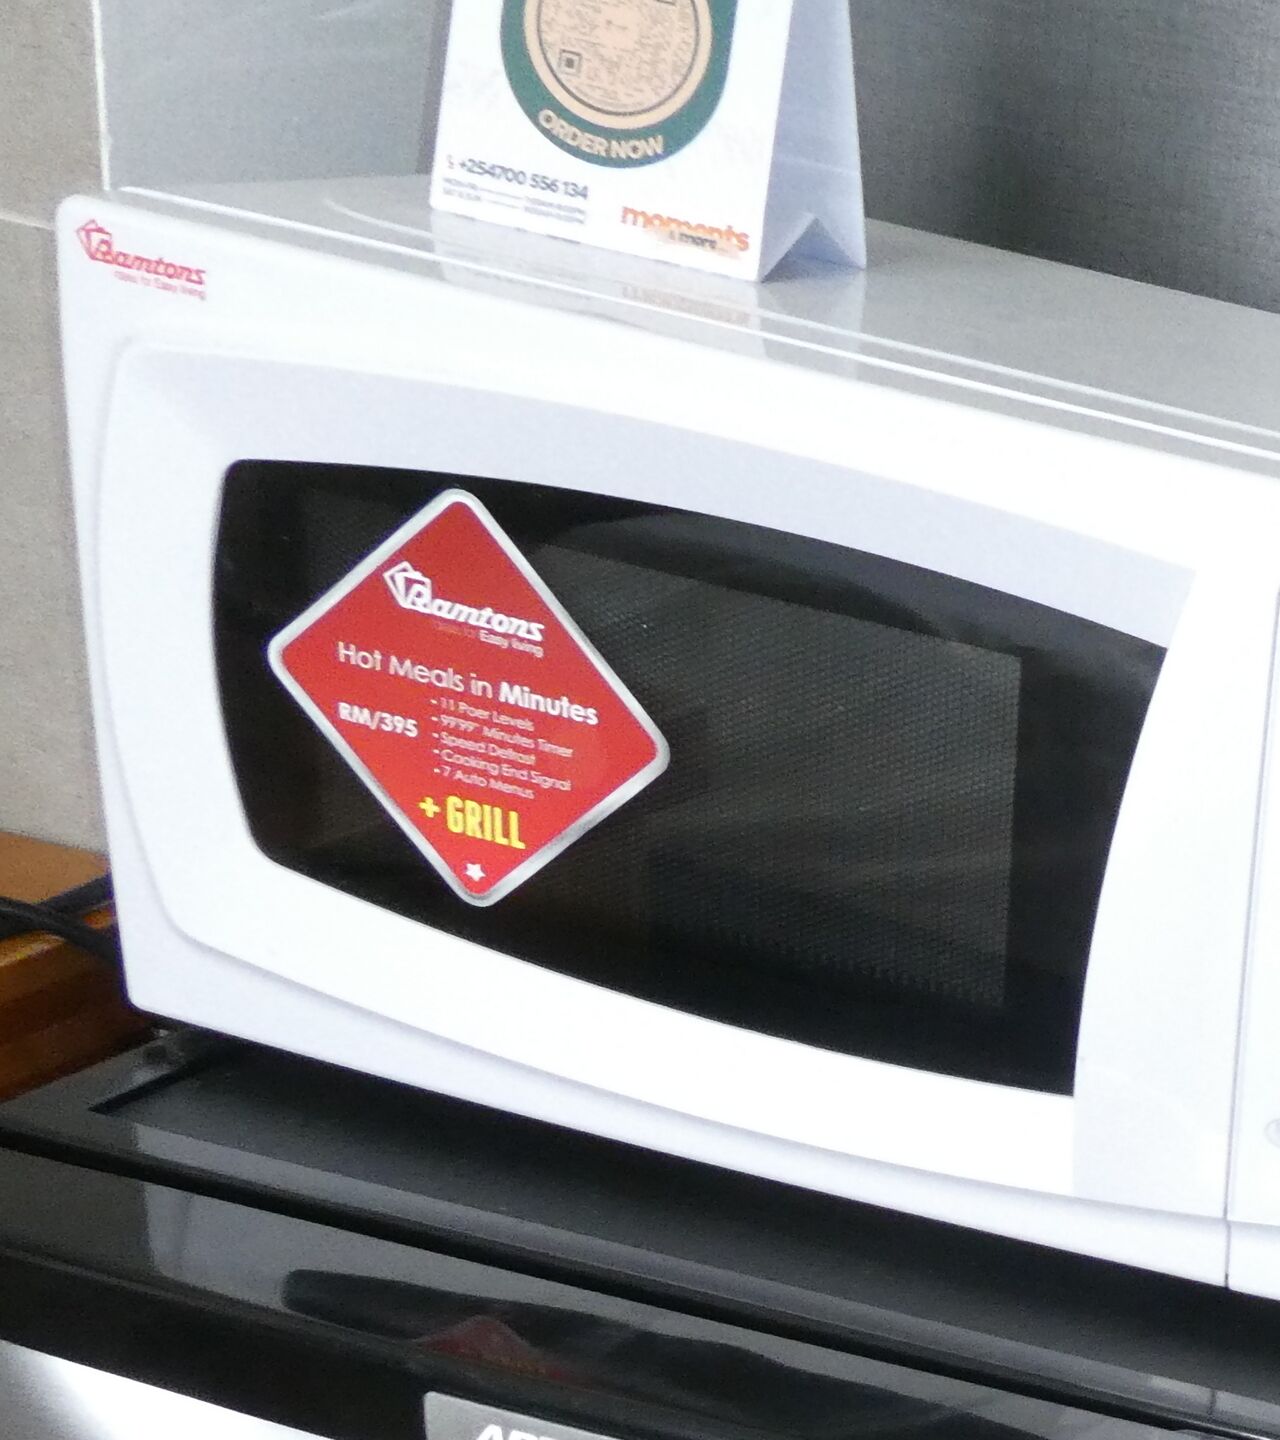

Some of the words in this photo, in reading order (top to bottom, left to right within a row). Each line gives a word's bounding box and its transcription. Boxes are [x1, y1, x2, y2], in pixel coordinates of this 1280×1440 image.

[538, 109, 609, 157] ORDER
[610, 134, 664, 159] NOW
[459, 158, 527, 185] +254700
[529, 173, 559, 193] 556
[563, 181, 588, 200] 134
[620, 206, 749, 251] moments
[394, 572, 545, 642] Ramtons
[337, 641, 382, 671] Hot
[389, 655, 465, 692] Meals
[470, 672, 493, 699] in
[499, 681, 600, 725] Minutes
[337, 702, 419, 737] RM/395
[440, 749, 500, 776] Cooking
[446, 794, 526, 850] GRILL
